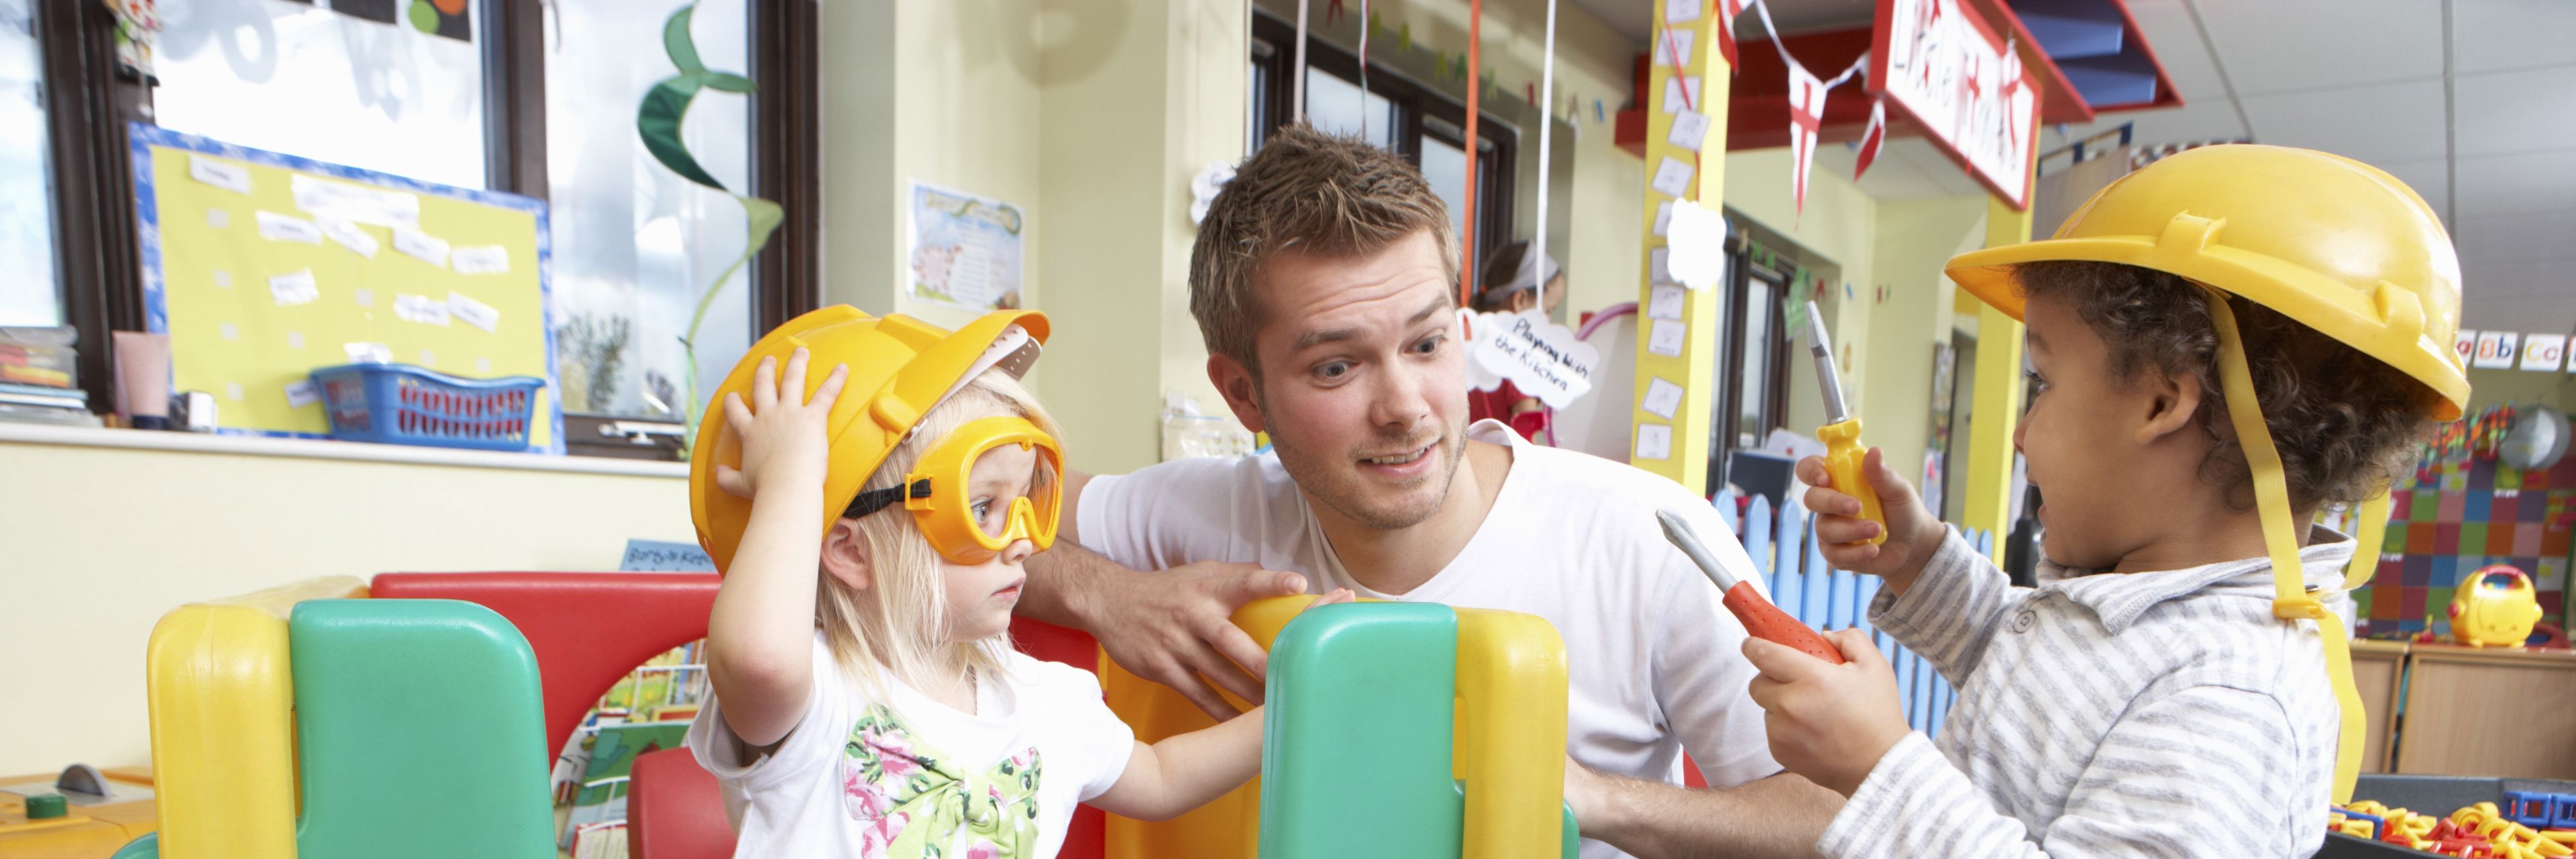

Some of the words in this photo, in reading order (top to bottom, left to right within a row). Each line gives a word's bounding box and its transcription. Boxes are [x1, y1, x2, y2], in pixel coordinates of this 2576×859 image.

[1495, 335, 1517, 356] the
[1513, 317, 1559, 364] Playing
[2479, 334, 2512, 359] Bb
